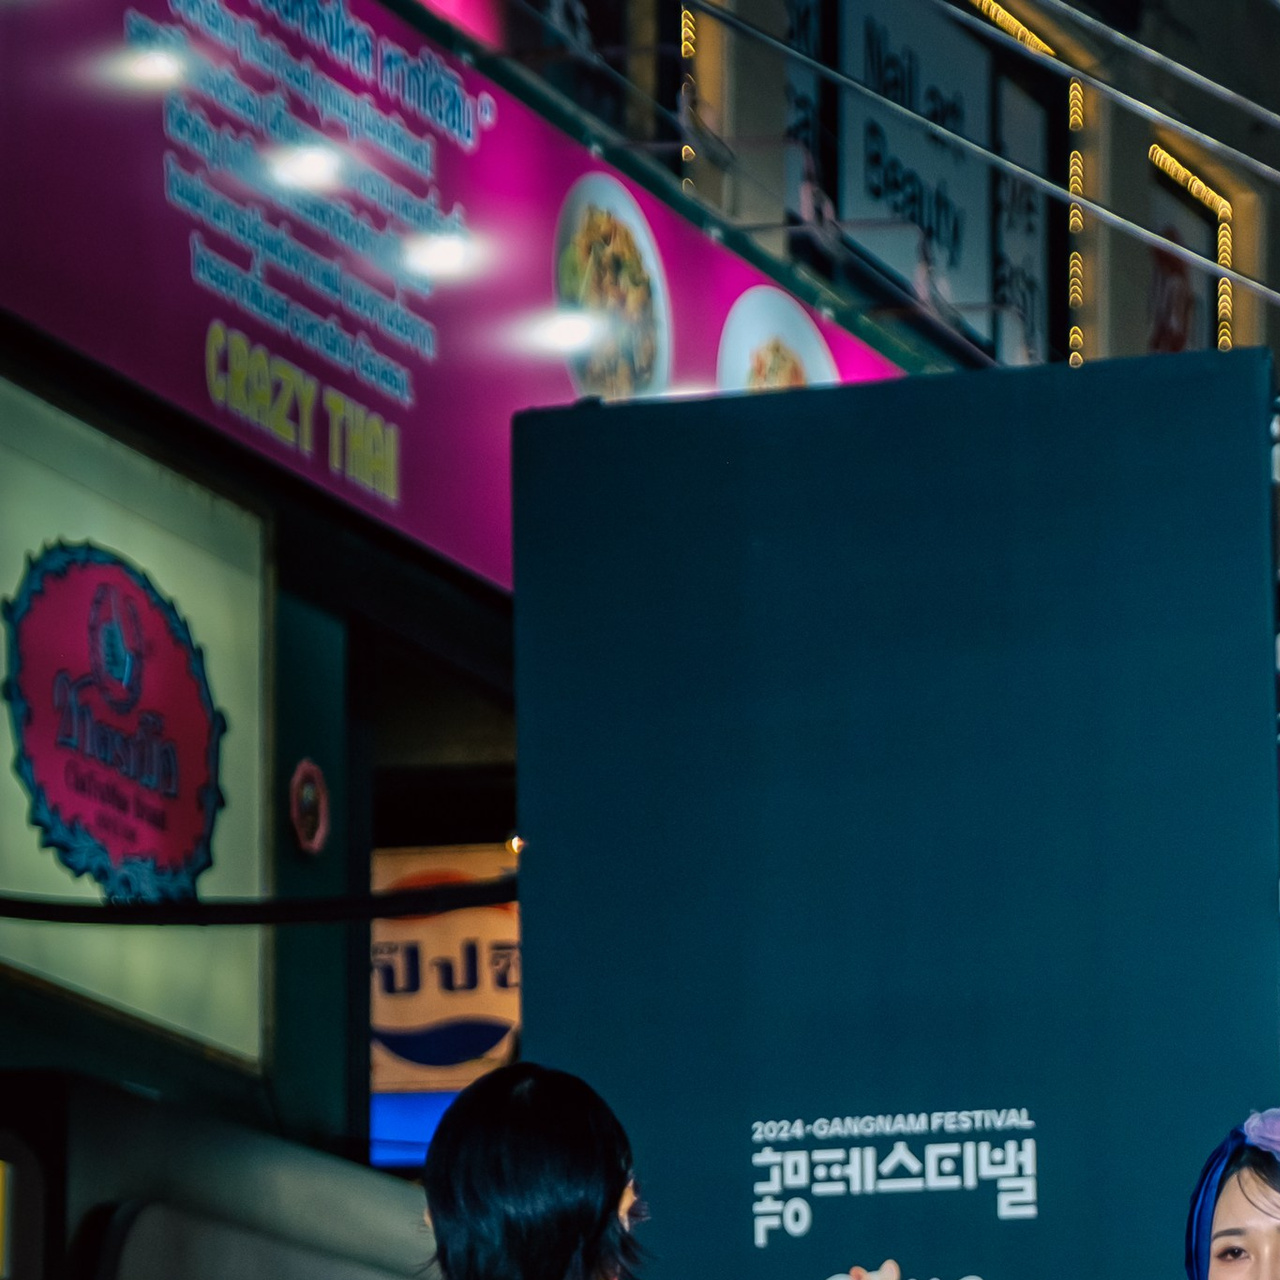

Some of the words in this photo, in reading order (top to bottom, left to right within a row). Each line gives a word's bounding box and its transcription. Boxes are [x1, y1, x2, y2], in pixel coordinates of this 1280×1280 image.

[205, 318, 320, 459] CRAZY
[322, 384, 400, 508] THAI
[930, 1107, 1036, 1135] FESTIVAL
